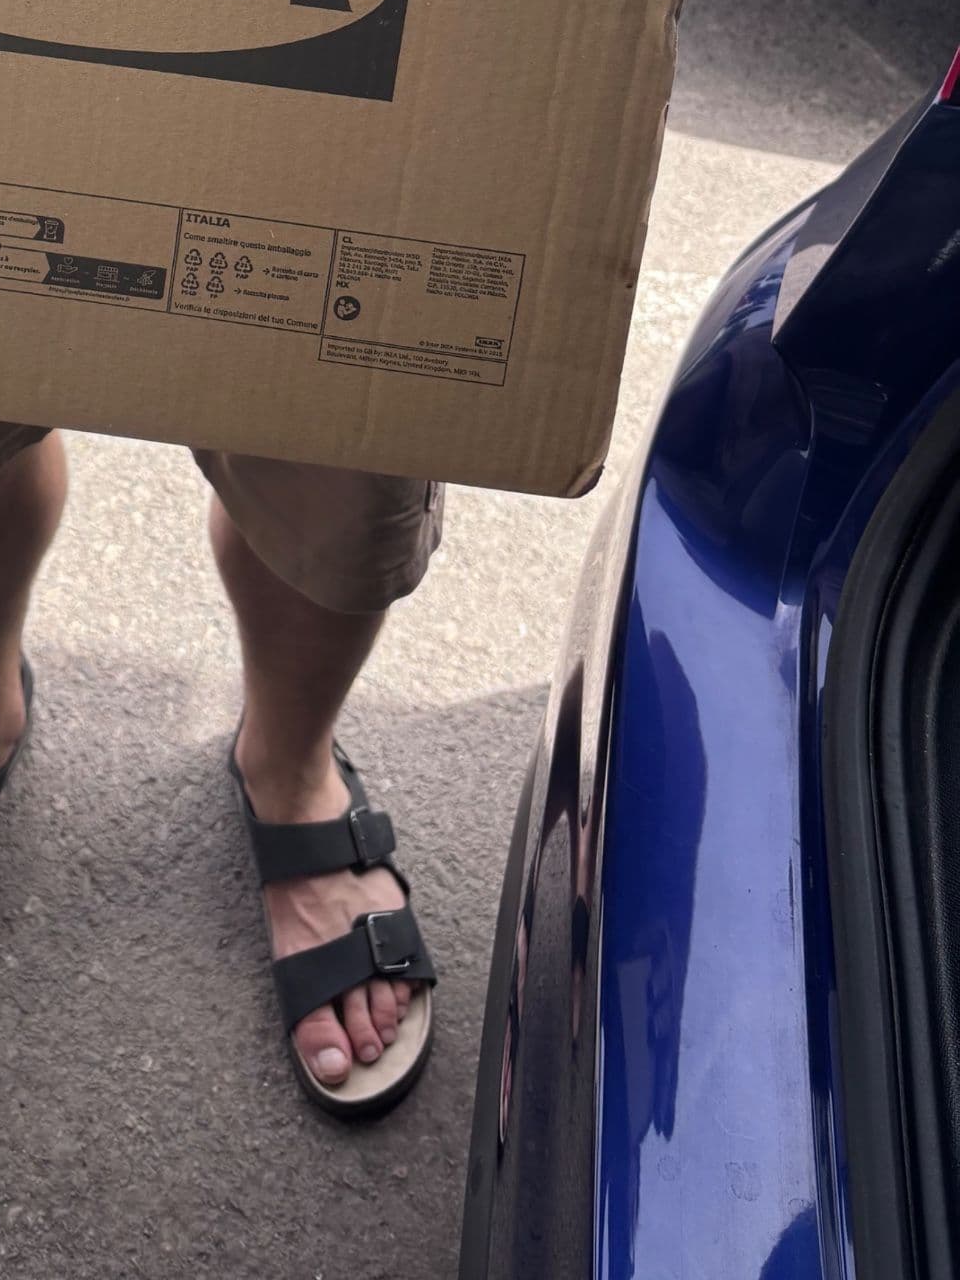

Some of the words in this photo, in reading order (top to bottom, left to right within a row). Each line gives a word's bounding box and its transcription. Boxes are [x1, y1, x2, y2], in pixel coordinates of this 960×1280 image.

[186, 213, 231, 228] ITALIA
[183, 232, 206, 242] Come
[207, 235, 239, 246] smaltire
[239, 240, 266, 252] questo
[342, 236, 353, 244] CL
[335, 280, 350, 289] MX
[174, 302, 202, 313] Verifica
[204, 306, 212, 314] le
[213, 308, 256, 321] disposizioni
[258, 314, 270, 322] del
[271, 316, 285, 324] tuo
[286, 318, 318, 329] Comune
[327, 343, 355, 353] Imported
